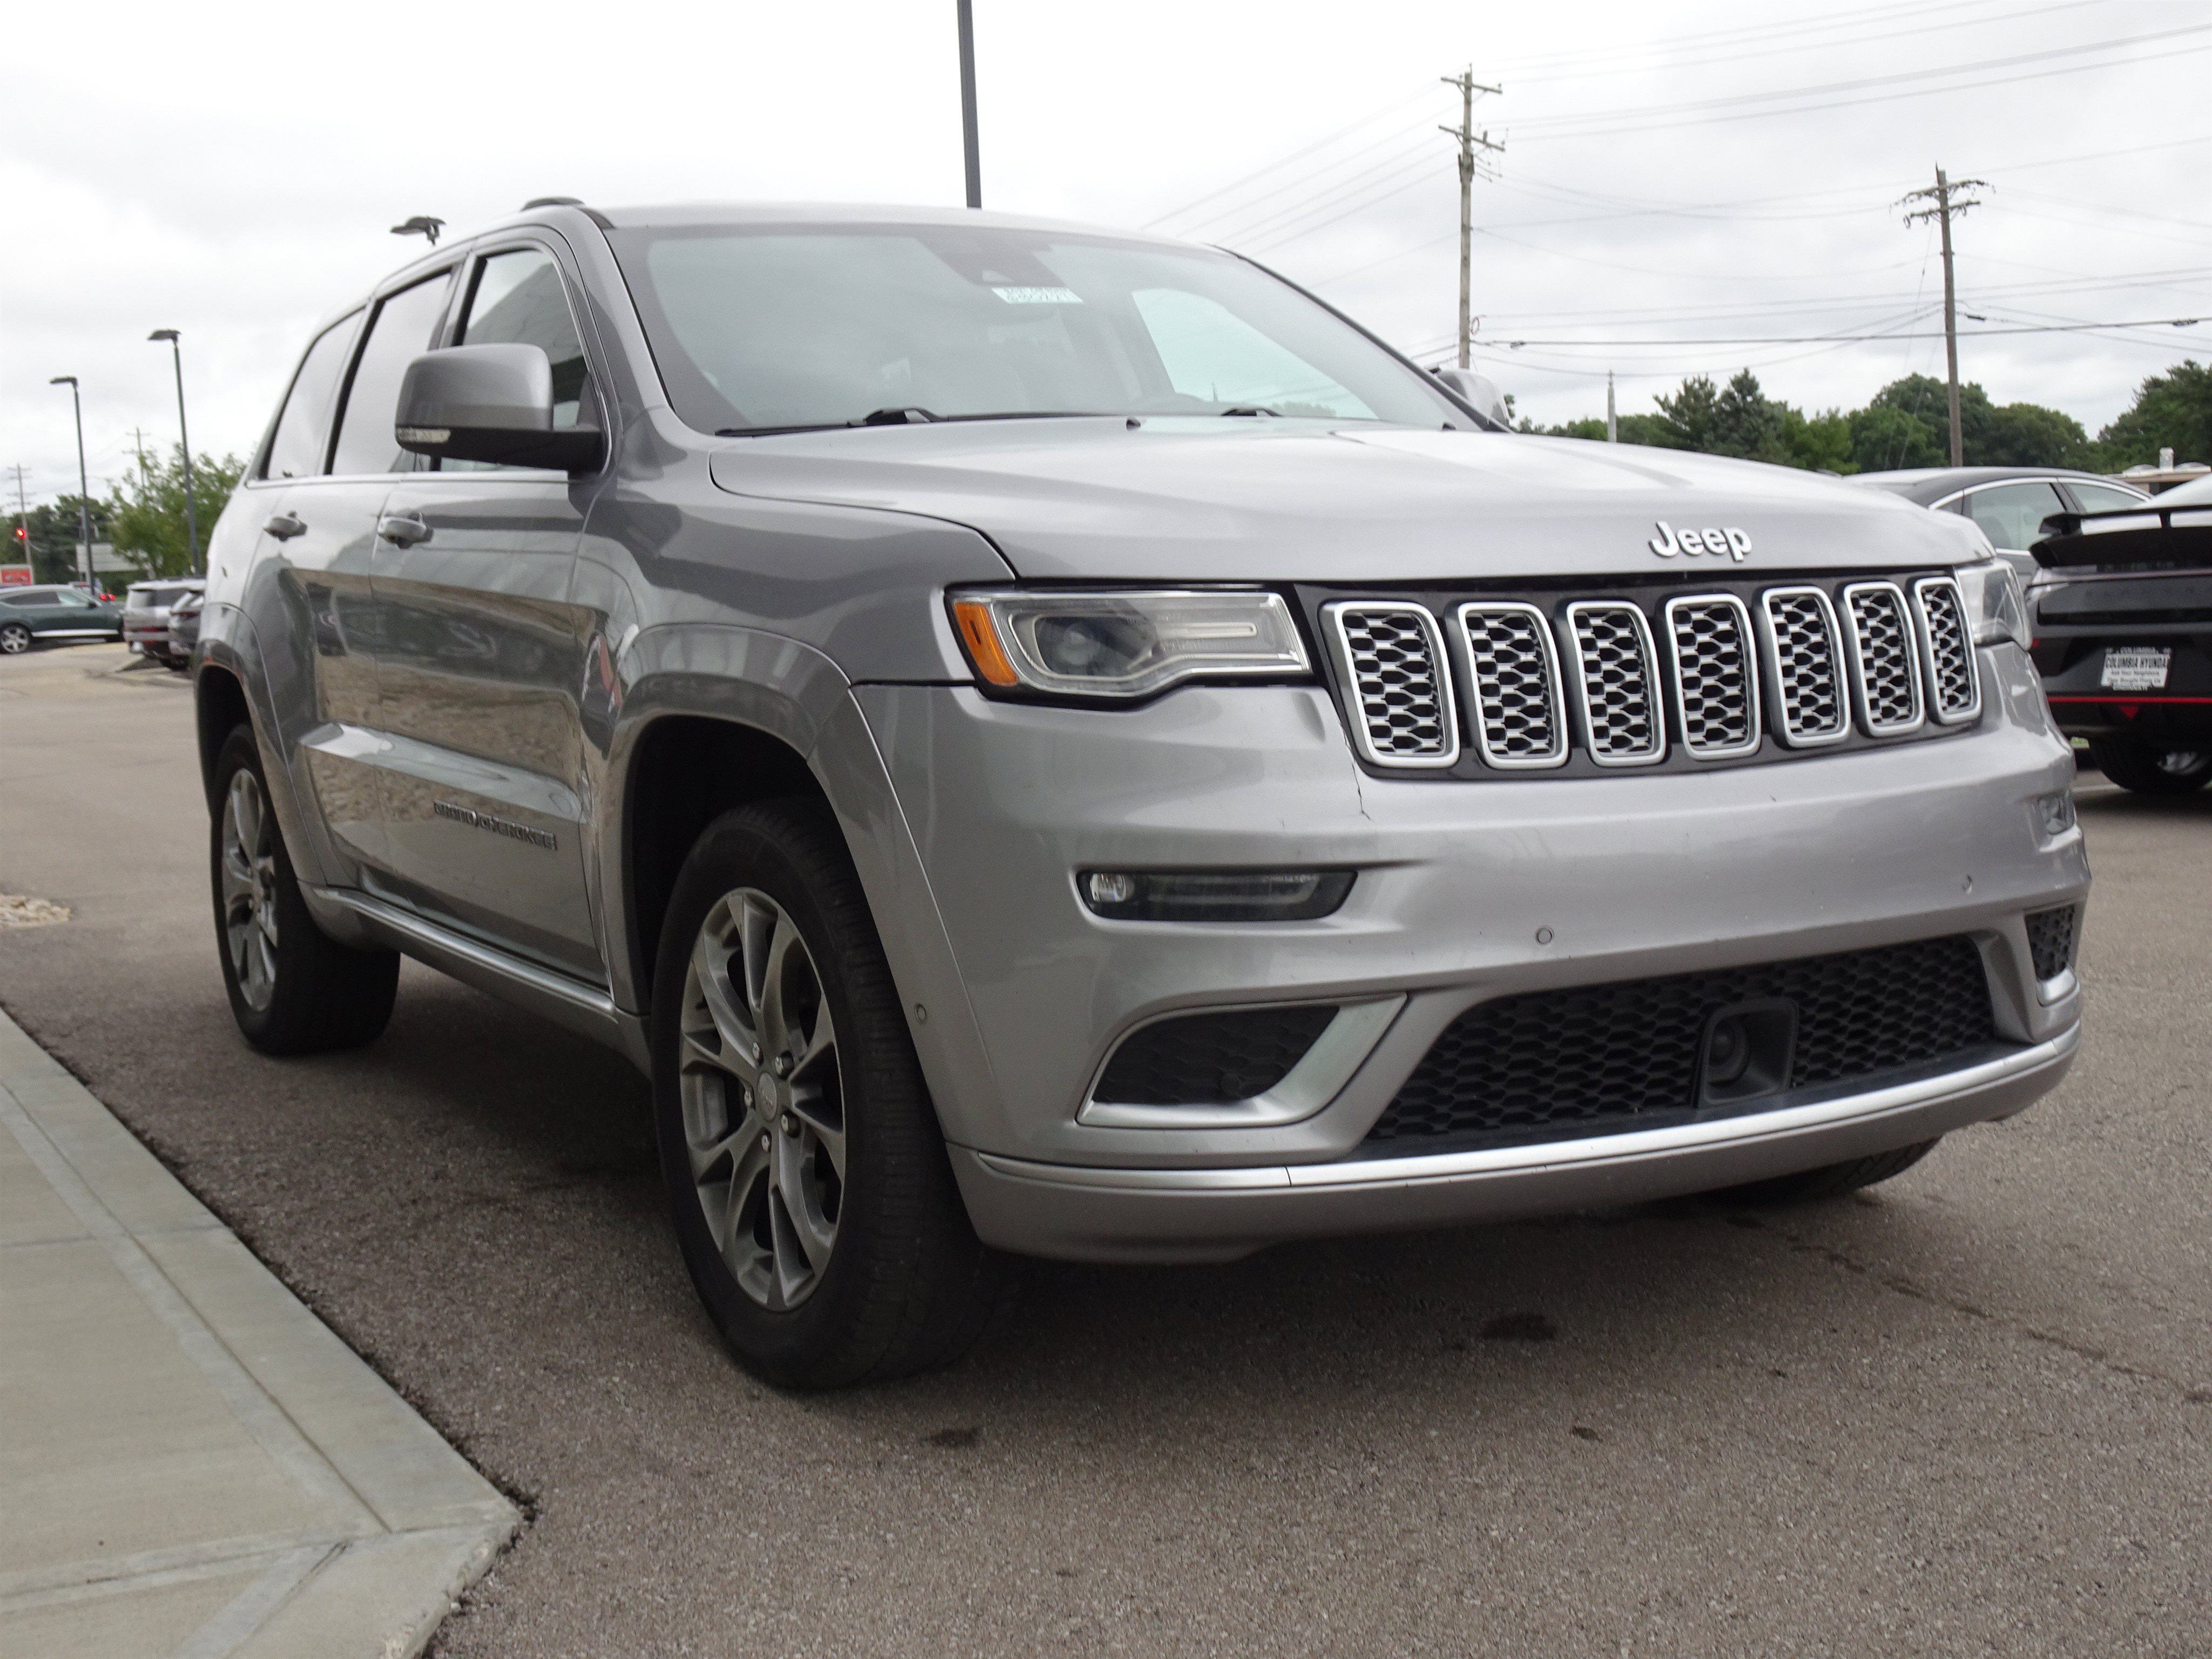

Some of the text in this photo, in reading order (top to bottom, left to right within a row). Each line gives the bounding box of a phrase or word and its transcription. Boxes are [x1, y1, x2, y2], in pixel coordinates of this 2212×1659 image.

[1649, 521, 1752, 562] Jeep
[2106, 656, 2167, 668] COLUMBIA HYUNDAI
